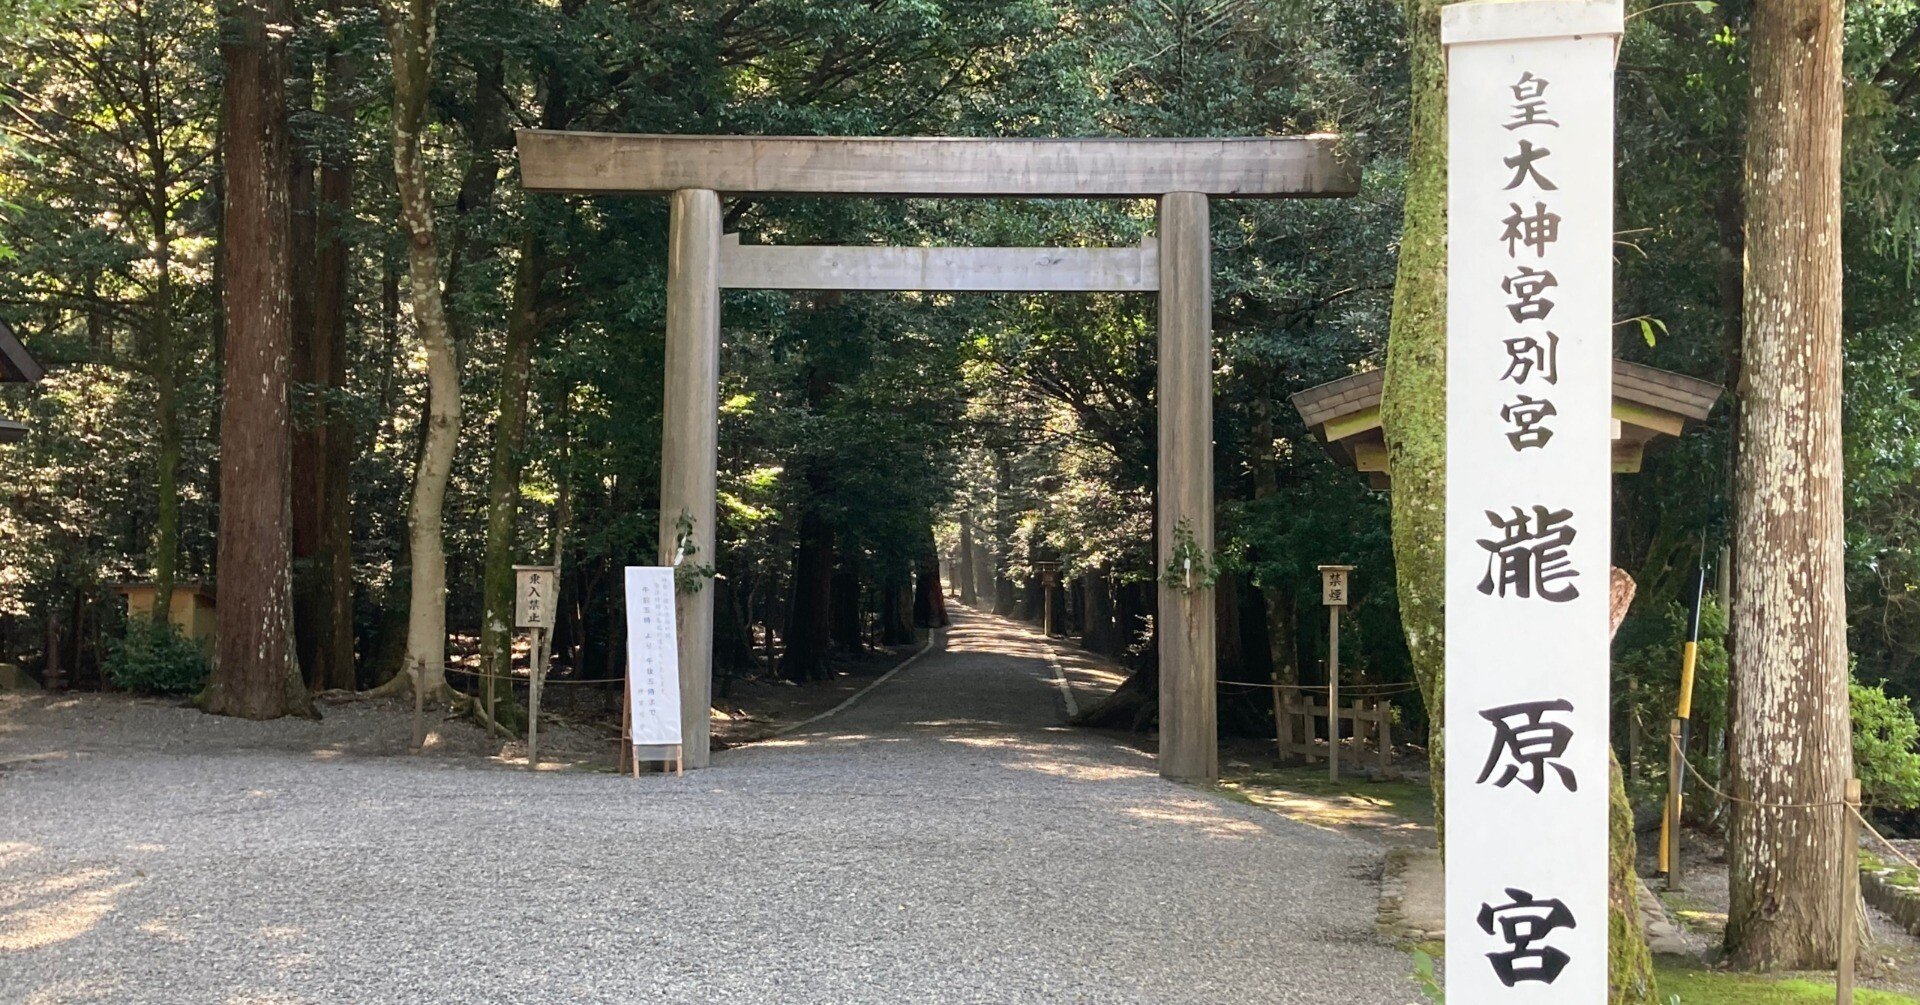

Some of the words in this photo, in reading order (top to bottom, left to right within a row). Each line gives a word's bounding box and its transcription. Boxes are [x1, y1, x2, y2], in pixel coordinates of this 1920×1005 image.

[1499, 71, 1562, 452] 皇大神宮別宮
[1328, 572, 1342, 601] 禁煙
[1475, 505, 1580, 988] 瀧原宮
